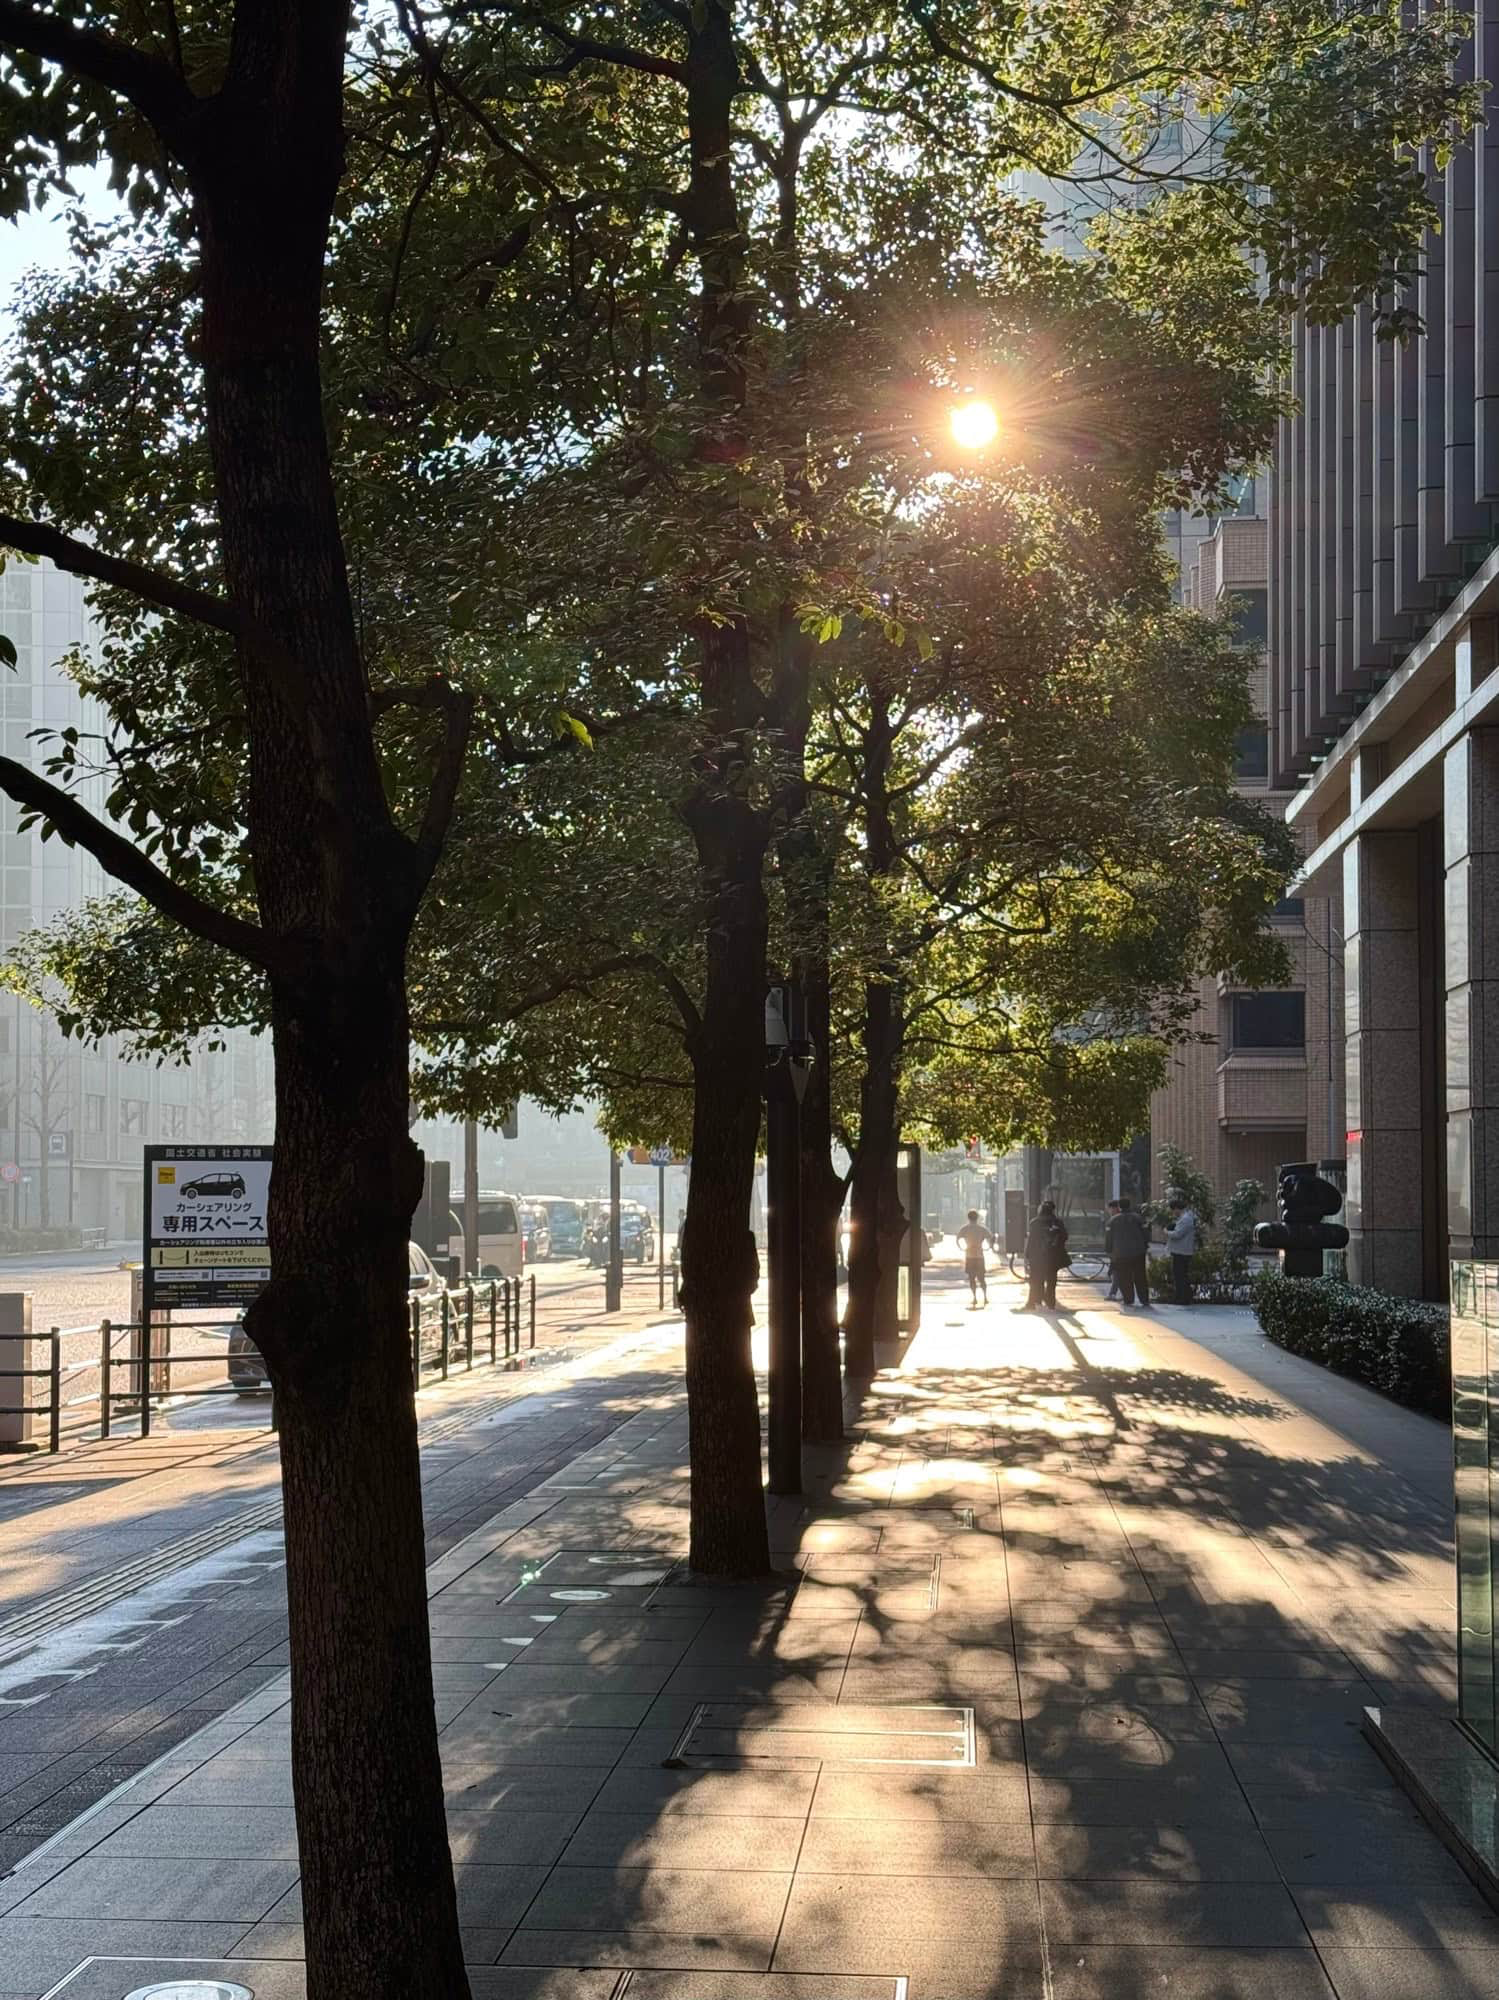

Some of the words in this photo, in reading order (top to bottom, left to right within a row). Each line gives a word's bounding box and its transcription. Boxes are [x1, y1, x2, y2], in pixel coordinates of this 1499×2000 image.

[176, 1203, 252, 1213] カーシェアリング
[162, 1216, 264, 1232] 専用スペース
